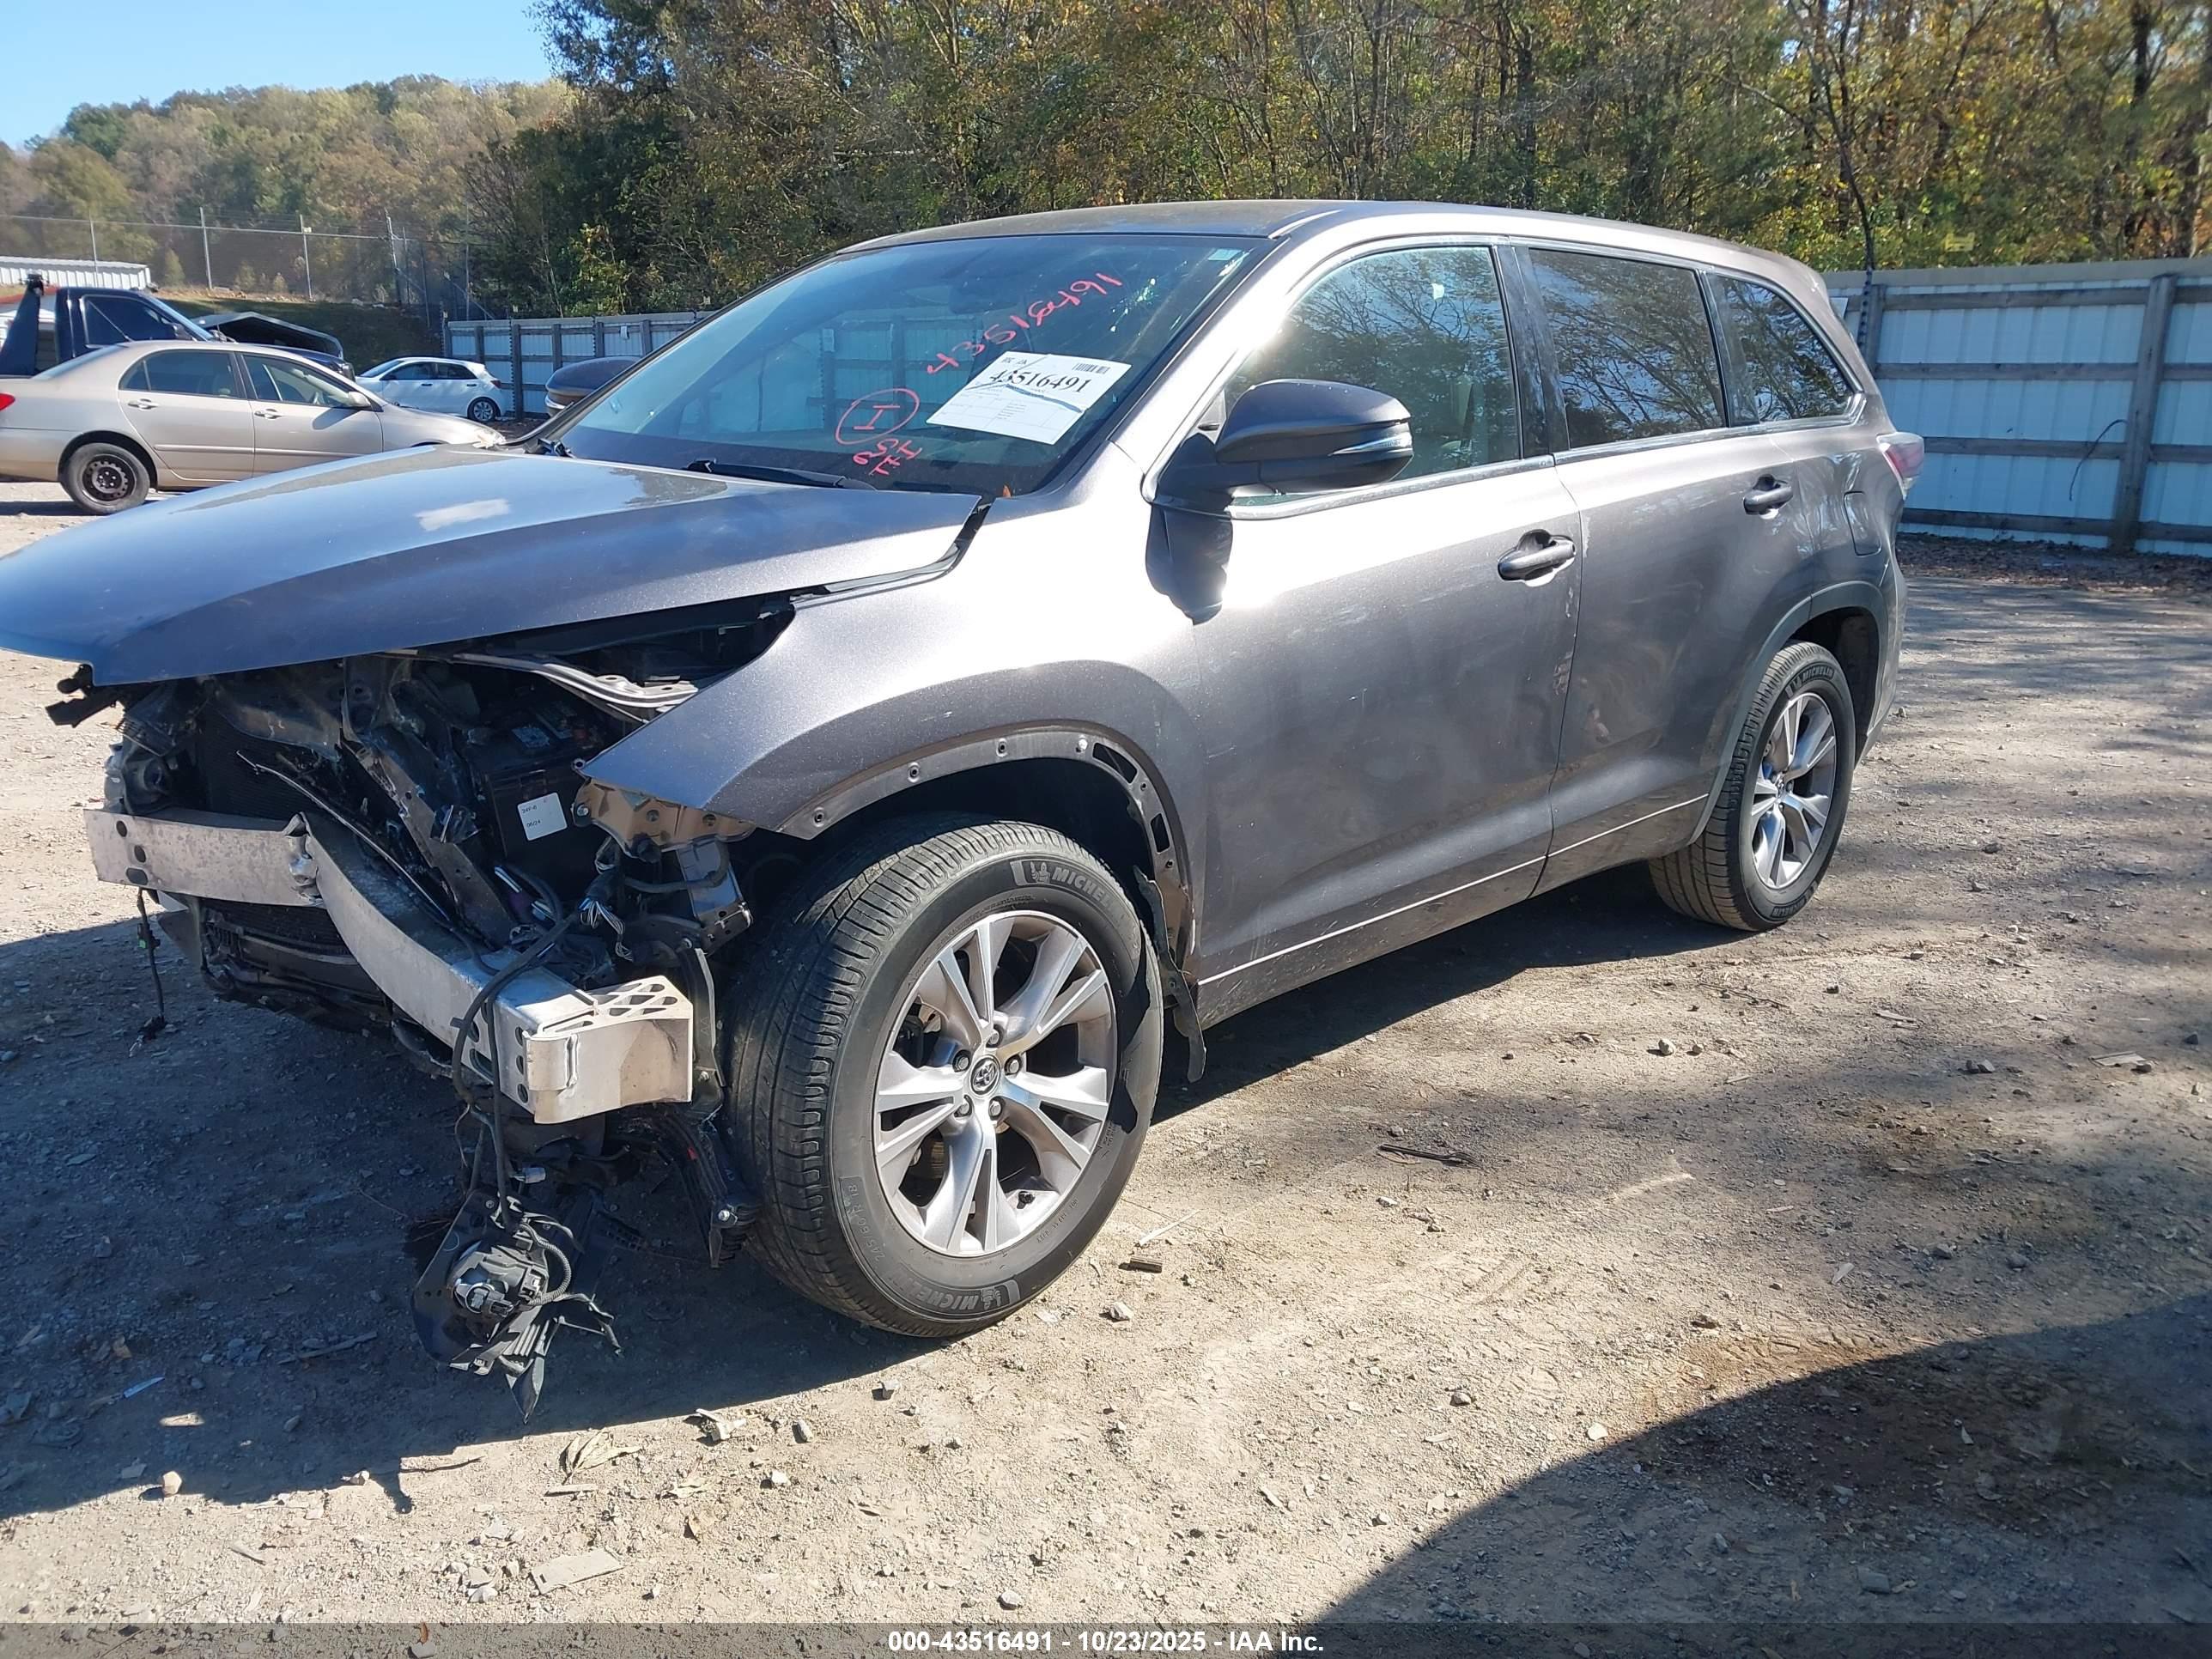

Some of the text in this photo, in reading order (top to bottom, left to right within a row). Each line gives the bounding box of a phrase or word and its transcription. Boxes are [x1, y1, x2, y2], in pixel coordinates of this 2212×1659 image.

[927, 272, 1123, 374] 43516491
[989, 369, 1092, 392] 43516491
[1051, 866, 1116, 910] MICHEL
